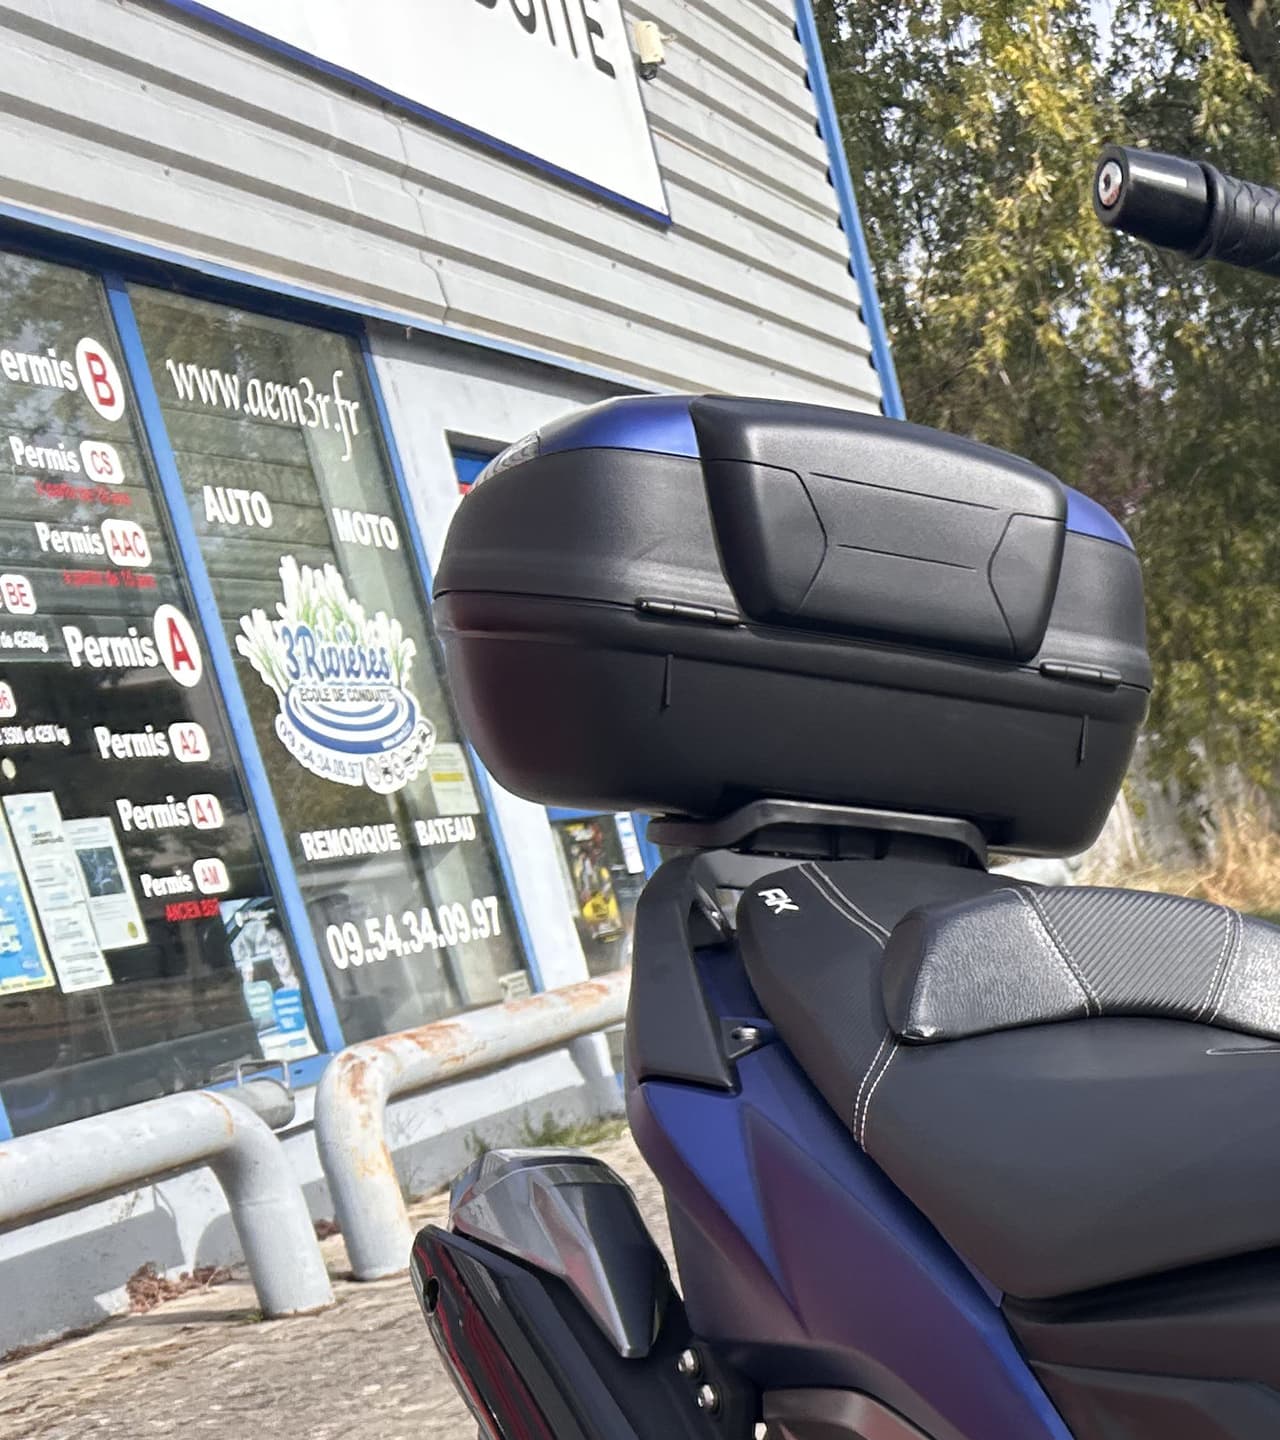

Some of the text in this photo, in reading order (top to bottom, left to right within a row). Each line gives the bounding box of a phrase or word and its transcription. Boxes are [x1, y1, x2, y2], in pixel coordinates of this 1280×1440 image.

[0, 348, 115, 407] ermis B
[166, 358, 359, 462] www.aem3r.fr
[9, 436, 80, 473] Permis
[203, 485, 273, 528] AUTO
[34, 522, 146, 558] Permis AAC
[332, 508, 399, 550] MOTO
[5, 582, 30, 607] BE
[62, 617, 196, 671] Permis A
[93, 725, 201, 759] Permis A2
[116, 795, 218, 831] Permis A1
[300, 816, 477, 861] REMORQUE BATEAU
[140, 866, 221, 898] Permis AM
[326, 896, 501, 970] 09.54.34.09.97
